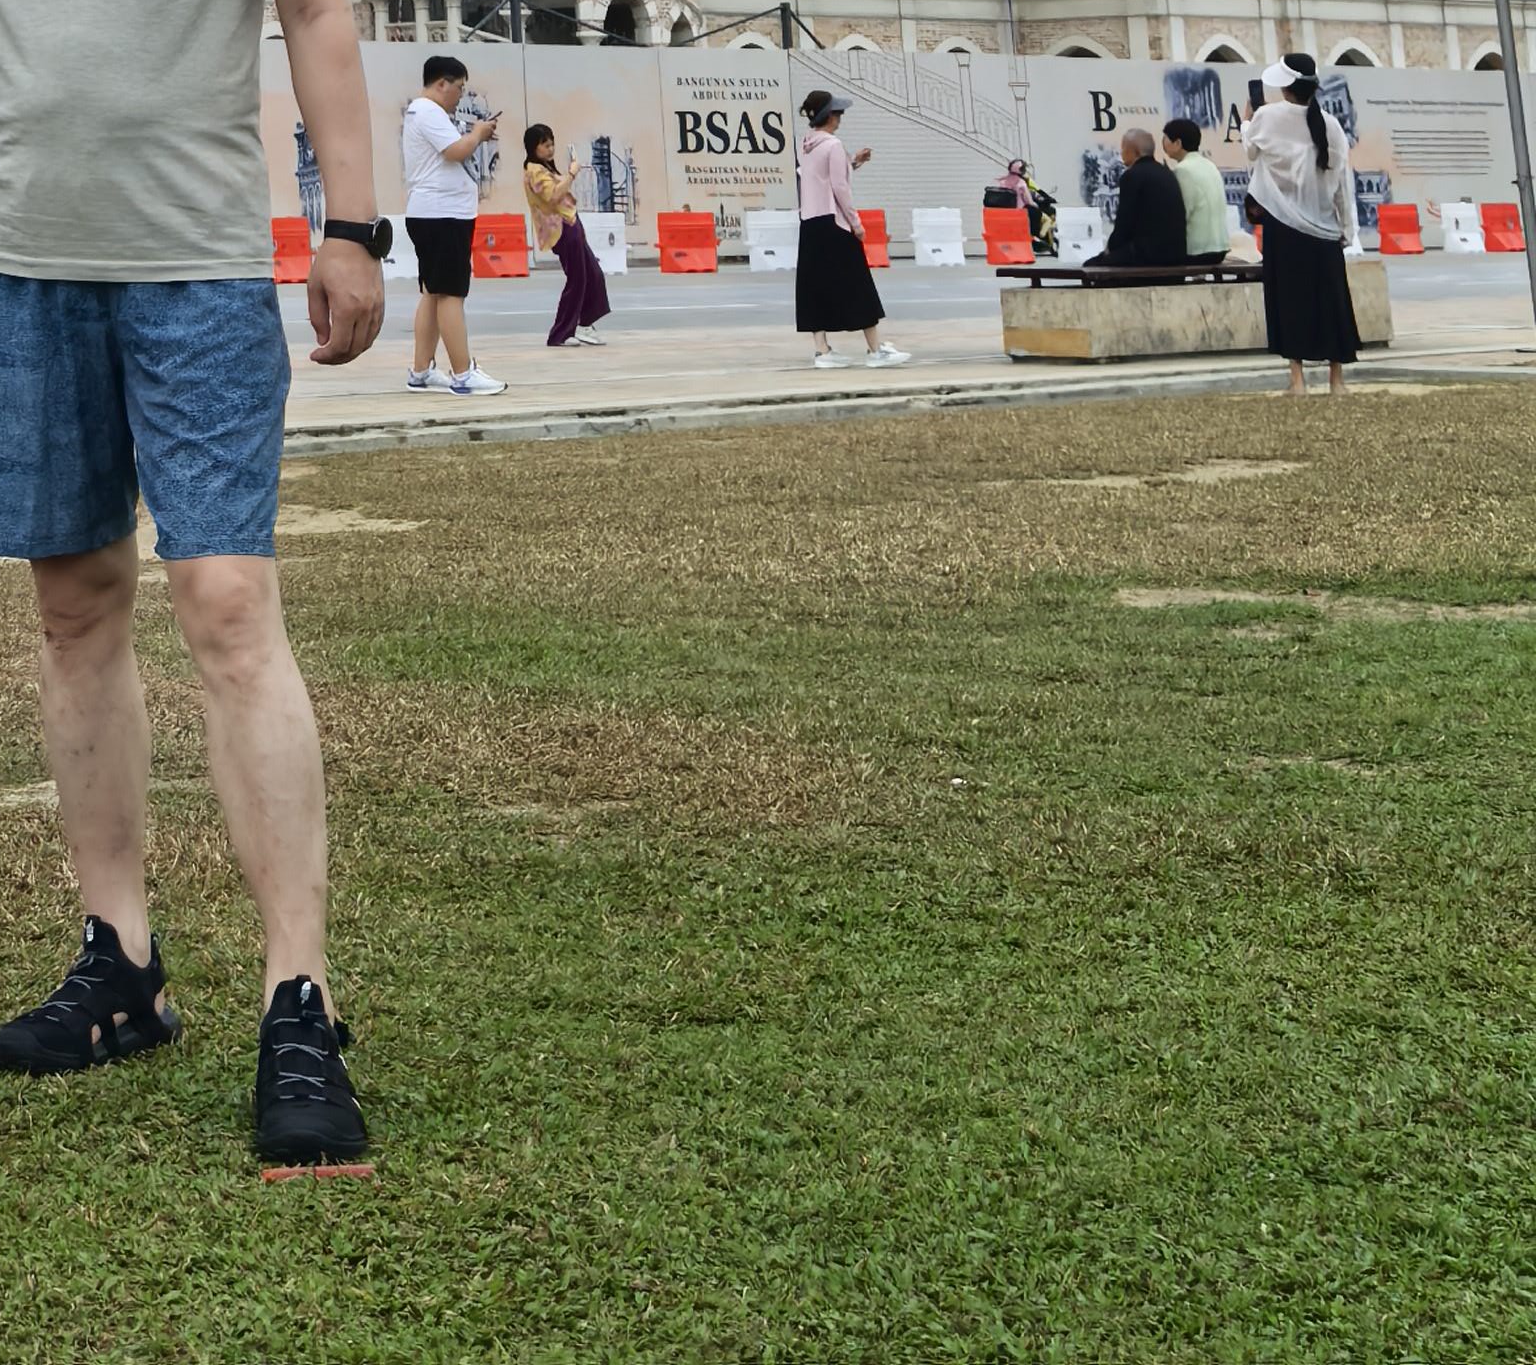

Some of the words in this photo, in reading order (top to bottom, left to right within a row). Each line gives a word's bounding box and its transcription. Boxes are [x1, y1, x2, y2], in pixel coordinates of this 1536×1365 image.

[677, 76, 735, 87] BANGUNAN
[739, 77, 780, 88] SULTAN
[692, 90, 728, 101] ABDUL
[730, 91, 767, 101] SAMAD
[674, 110, 786, 155] BSAS
